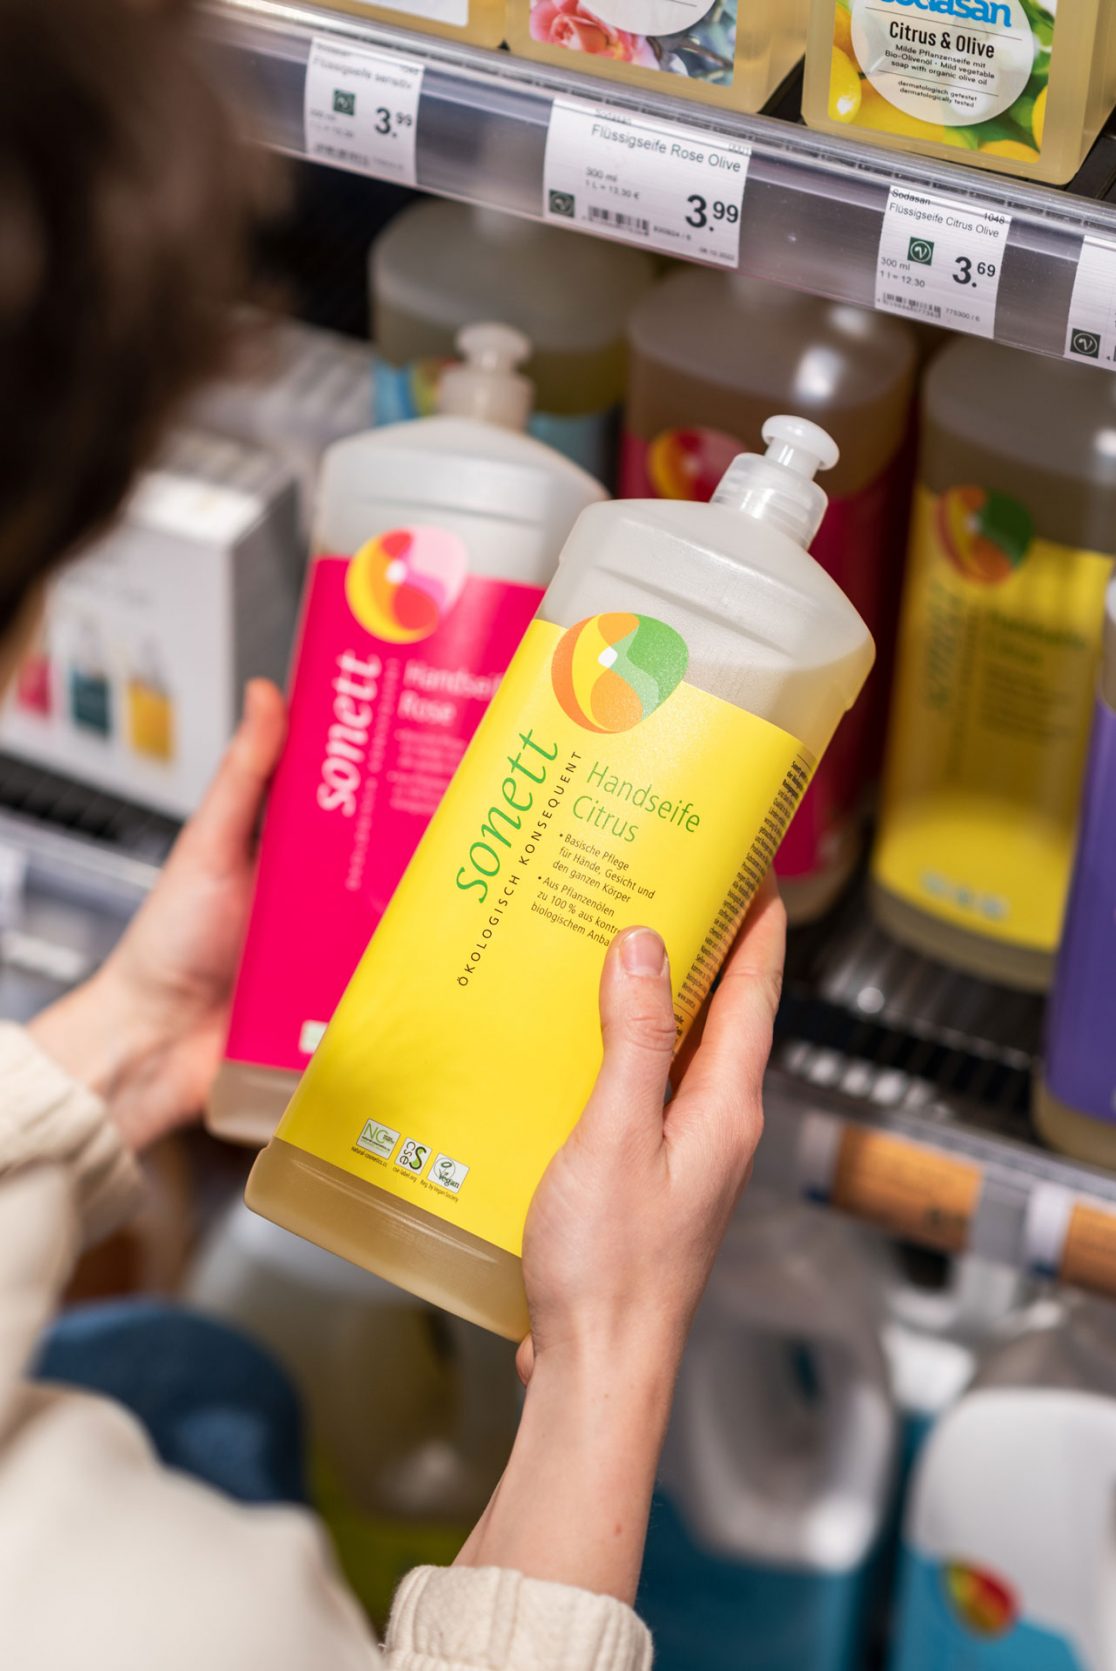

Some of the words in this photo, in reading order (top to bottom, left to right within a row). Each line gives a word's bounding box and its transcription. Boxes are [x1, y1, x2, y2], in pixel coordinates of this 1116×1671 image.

[889, 21, 937, 46] Citrus
[940, 32, 951, 49] &
[956, 35, 995, 58] Olive
[895, 44, 917, 54] Milde
[919, 49, 971, 65] Pflanzenseife
[973, 60, 986, 68] mit
[885, 49, 932, 65] Bio-Olivenöl
[940, 61, 957, 71] Mild
[958, 66, 995, 79] vegetable
[891, 61, 909, 70] soap
[911, 64, 927, 72] with
[928, 68, 956, 80] organic
[958, 73, 976, 83] olive
[898, 80, 948, 95] dermatologisch
[950, 91, 977, 101] getestet
[899, 88, 952, 104] dermatologically
[954, 98, 974, 108] tested
[591, 123, 667, 153] Flüssigseife
[670, 143, 704, 163] Rose
[708, 153, 741, 172] Olive
[685, 194, 739, 232] 3.99
[891, 188, 931, 206] Sodasan
[889, 202, 944, 223] Flüssigseife
[945, 216, 973, 232] Citrus
[975, 224, 999, 238] Olive
[880, 256, 897, 268] 300
[899, 262, 911, 271] ml
[952, 256, 996, 288] 3.69
[316, 648, 382, 818] sonett
[586, 761, 700, 833] Handseife
[456, 729, 558, 904] sonett
[572, 795, 639, 842] Citrus
[456, 874, 520, 987] ÖKOLOGISCH
[518, 751, 582, 866] KONSEQUENT
[564, 833, 601, 857] Basische
[601, 850, 630, 871] Pflege
[552, 860, 569, 873] den
[569, 869, 601, 888] ganzen
[601, 882, 632, 903] Körper
[559, 846, 572, 858] für
[573, 853, 602, 875] Hände,
[605, 868, 637, 891] Gesicht
[637, 886, 656, 899] und
[537, 890, 549, 901] zu
[550, 895, 568, 909] 100
[568, 903, 577, 914] %
[578, 910, 594, 923] aus
[542, 877, 560, 891] Aus
[560, 884, 615, 918] Pflanzenölen
[530, 900, 586, 935] biologischem
[587, 929, 610, 947] Anba
